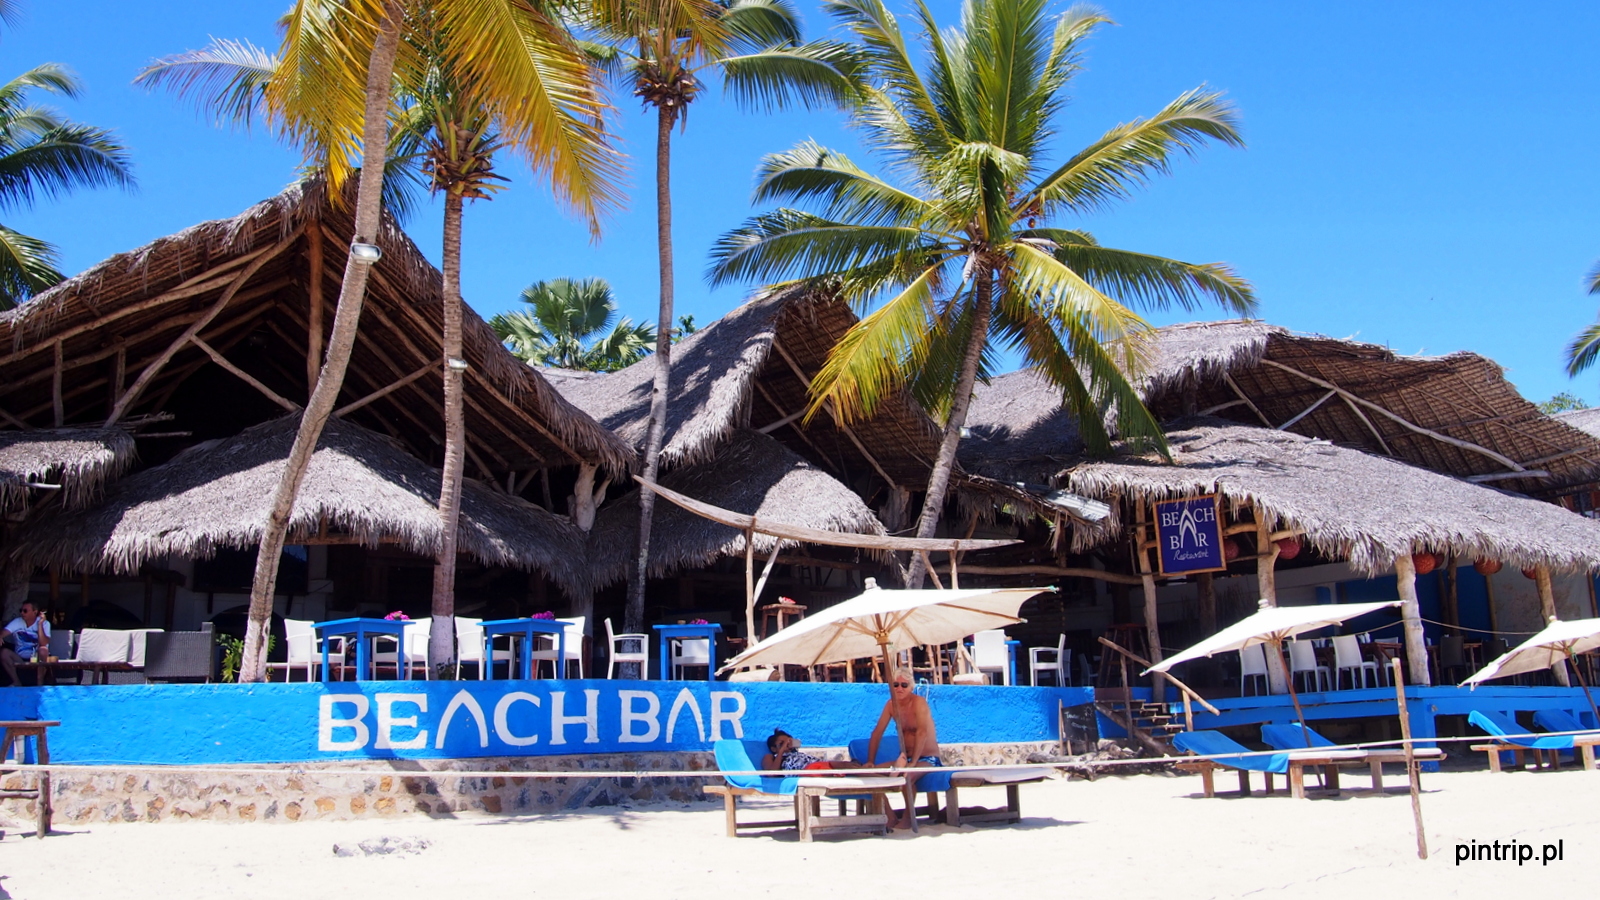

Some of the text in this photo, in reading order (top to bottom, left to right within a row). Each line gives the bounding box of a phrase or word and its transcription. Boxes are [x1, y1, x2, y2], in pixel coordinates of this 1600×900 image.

[1161, 507, 1215, 535] BEACH
[1169, 519, 1209, 550] BAR
[318, 687, 747, 752] BEACH BAR
